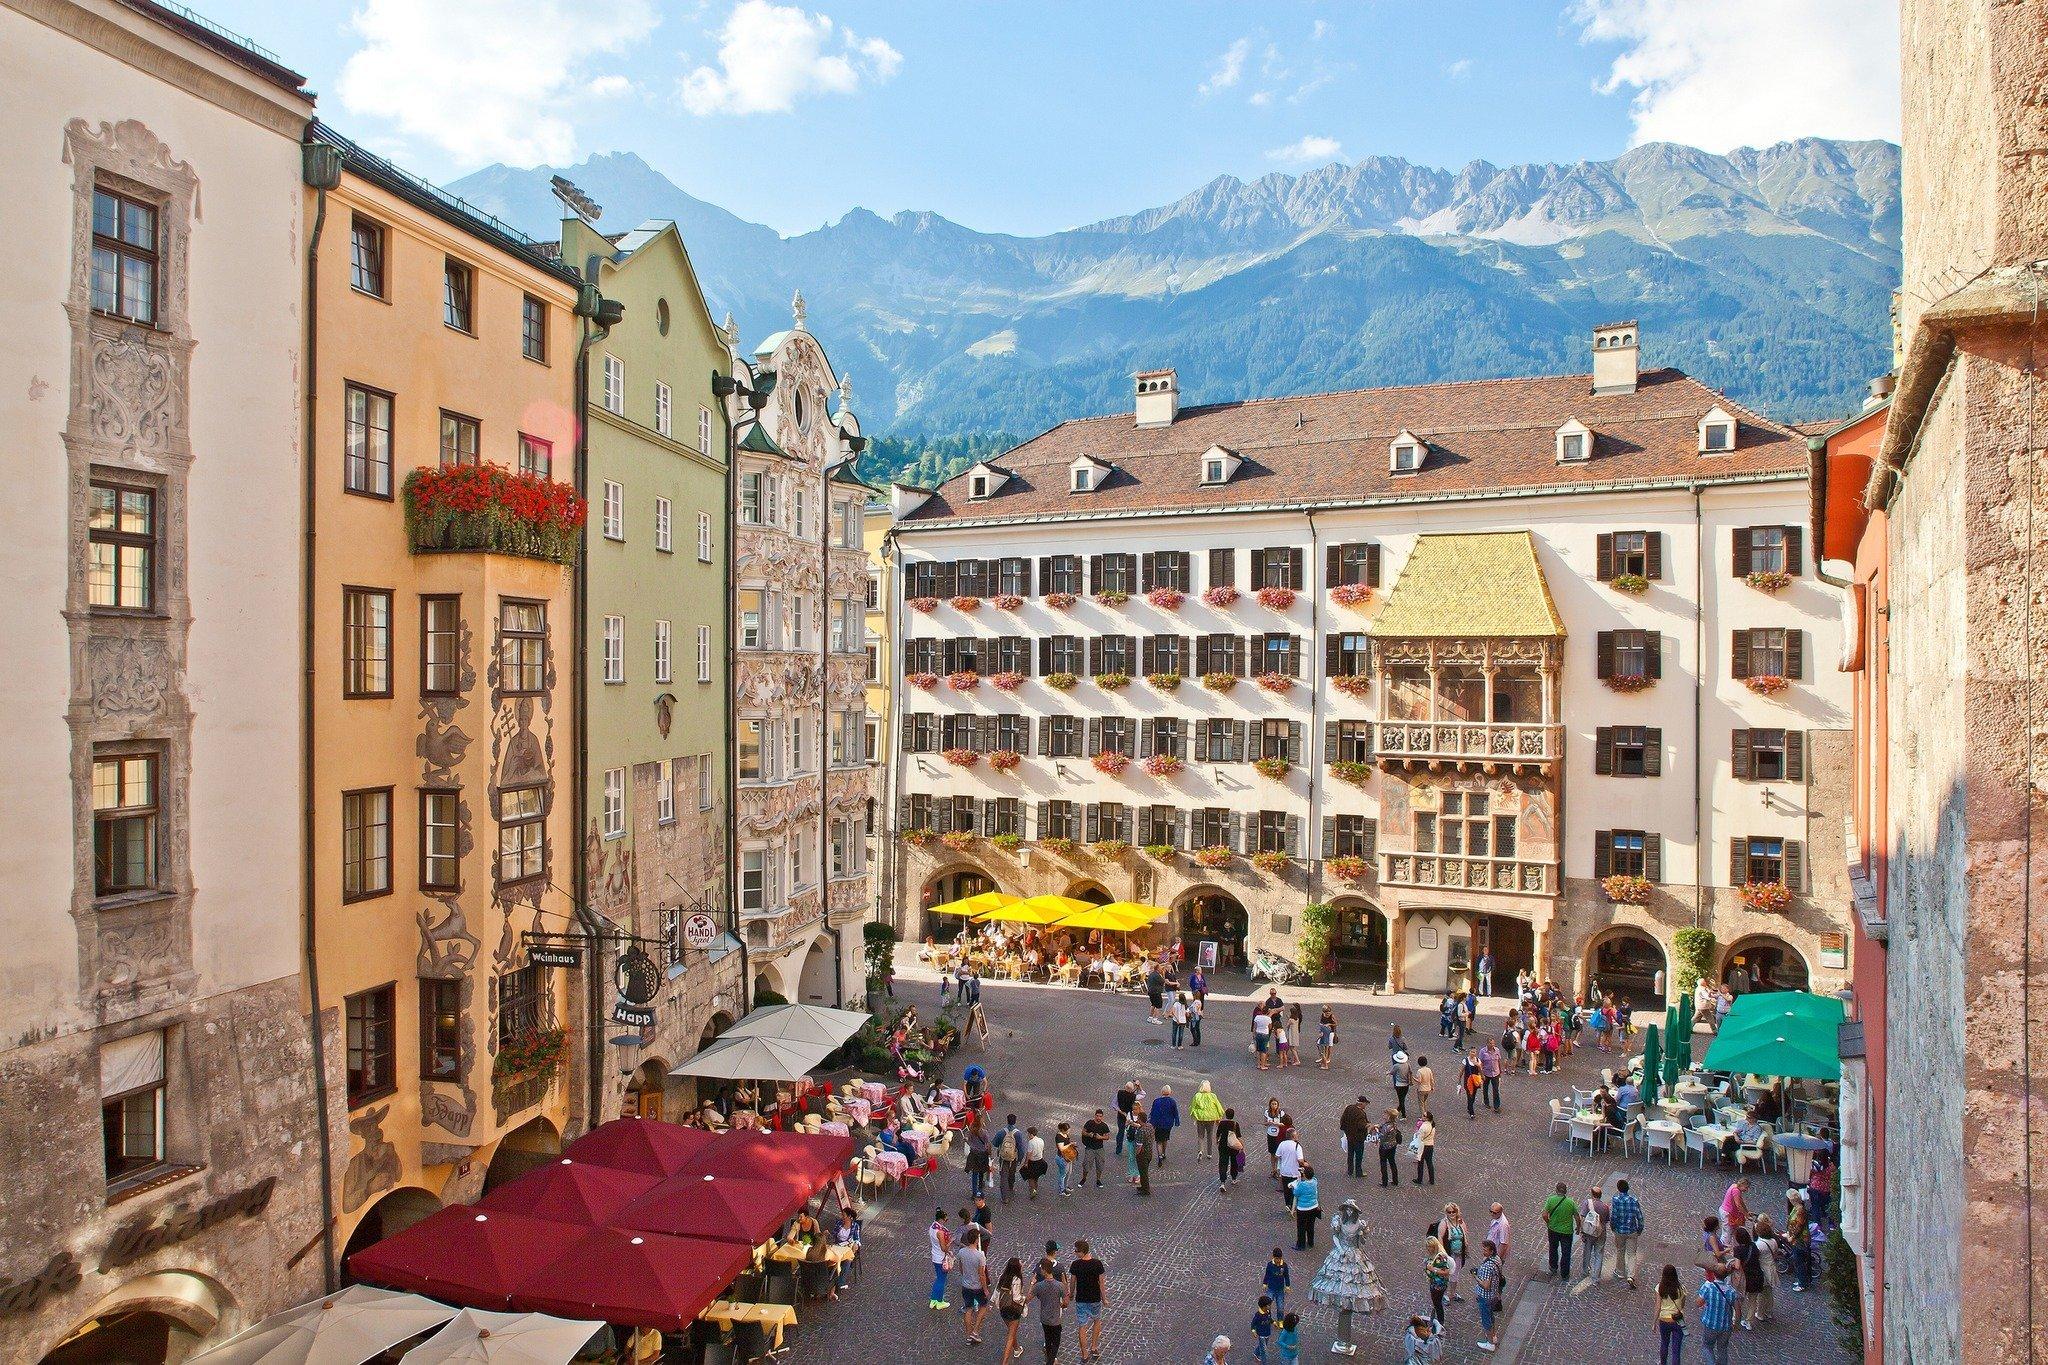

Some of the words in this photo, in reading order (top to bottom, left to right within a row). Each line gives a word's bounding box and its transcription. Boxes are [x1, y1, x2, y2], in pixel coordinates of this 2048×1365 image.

[688, 926, 714, 937] HANDL
[531, 951, 575, 964] Weinhaus
[616, 1008, 651, 1025] Happ
